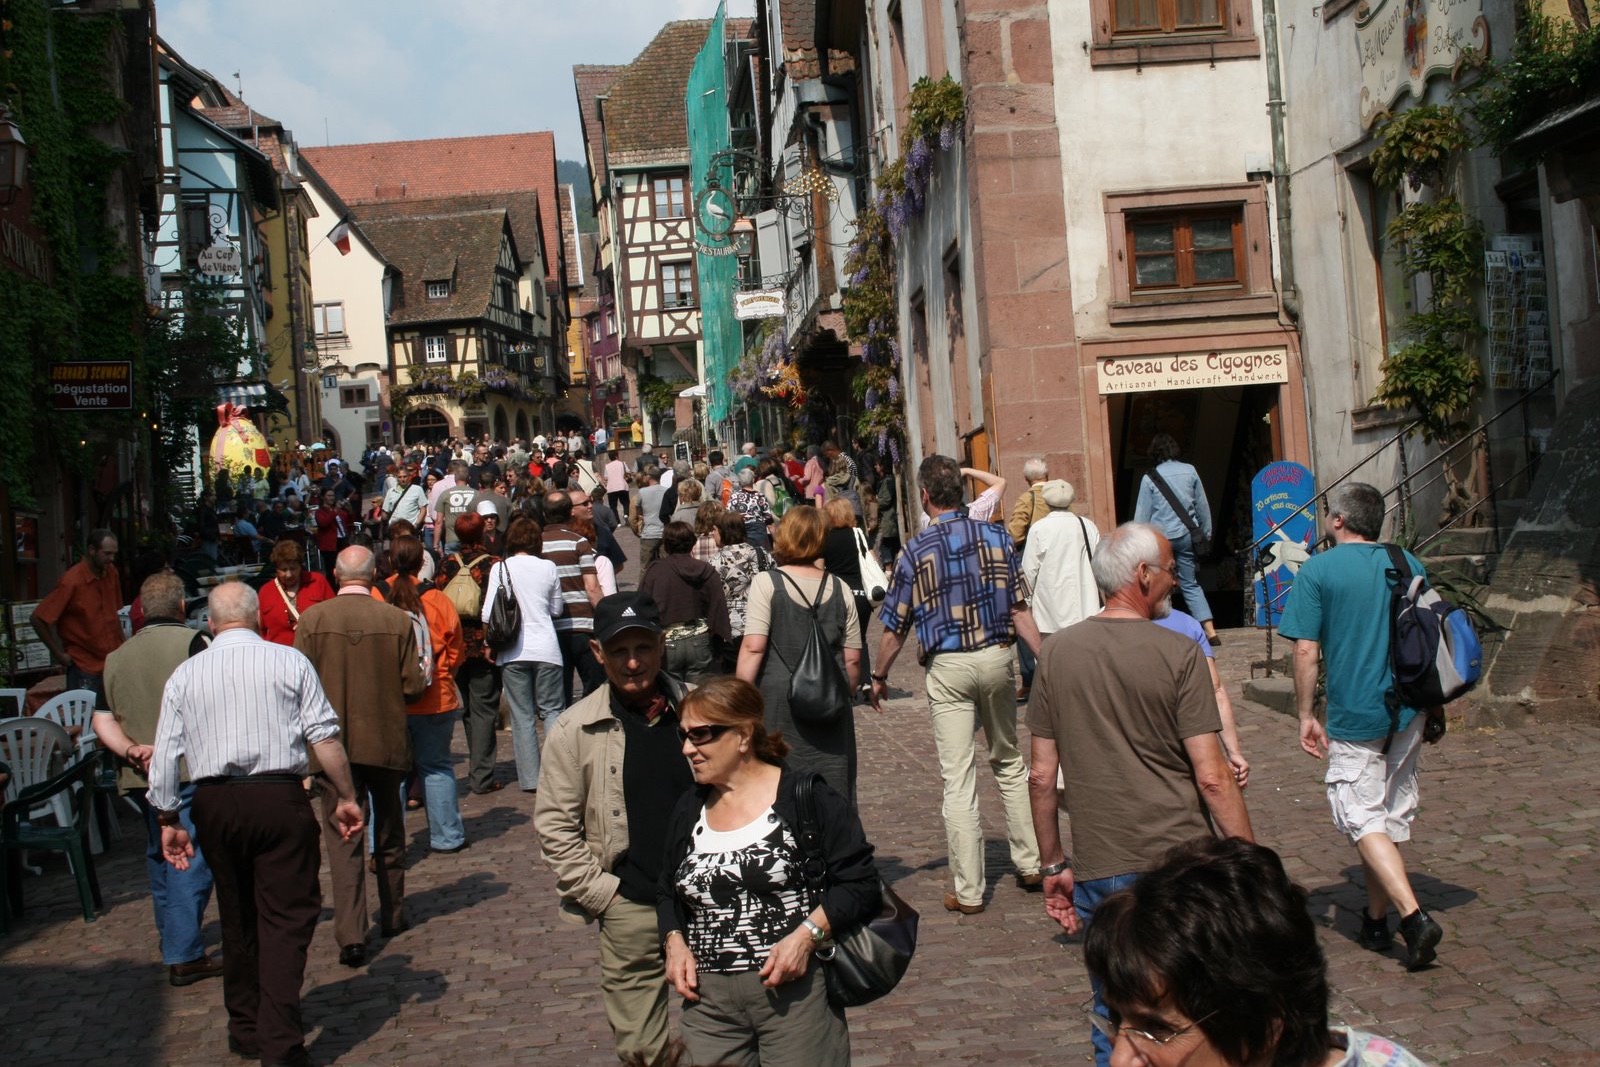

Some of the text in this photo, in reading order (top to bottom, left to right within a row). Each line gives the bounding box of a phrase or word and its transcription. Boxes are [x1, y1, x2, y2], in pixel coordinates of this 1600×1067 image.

[698, 241, 742, 256] RESTAURANT
[201, 250, 233, 261] Au Cep
[202, 263, 212, 271] de
[1103, 352, 1282, 376] Caveau des Cigognes
[1106, 371, 1282, 391] Artisanat Handicraft Handwerk
[54, 383, 128, 396] Dégustation
[74, 395, 108, 405] Vente
[450, 493, 475, 506] 07
[1255, 500, 1264, 512] 20
[1271, 502, 1285, 510] vous
